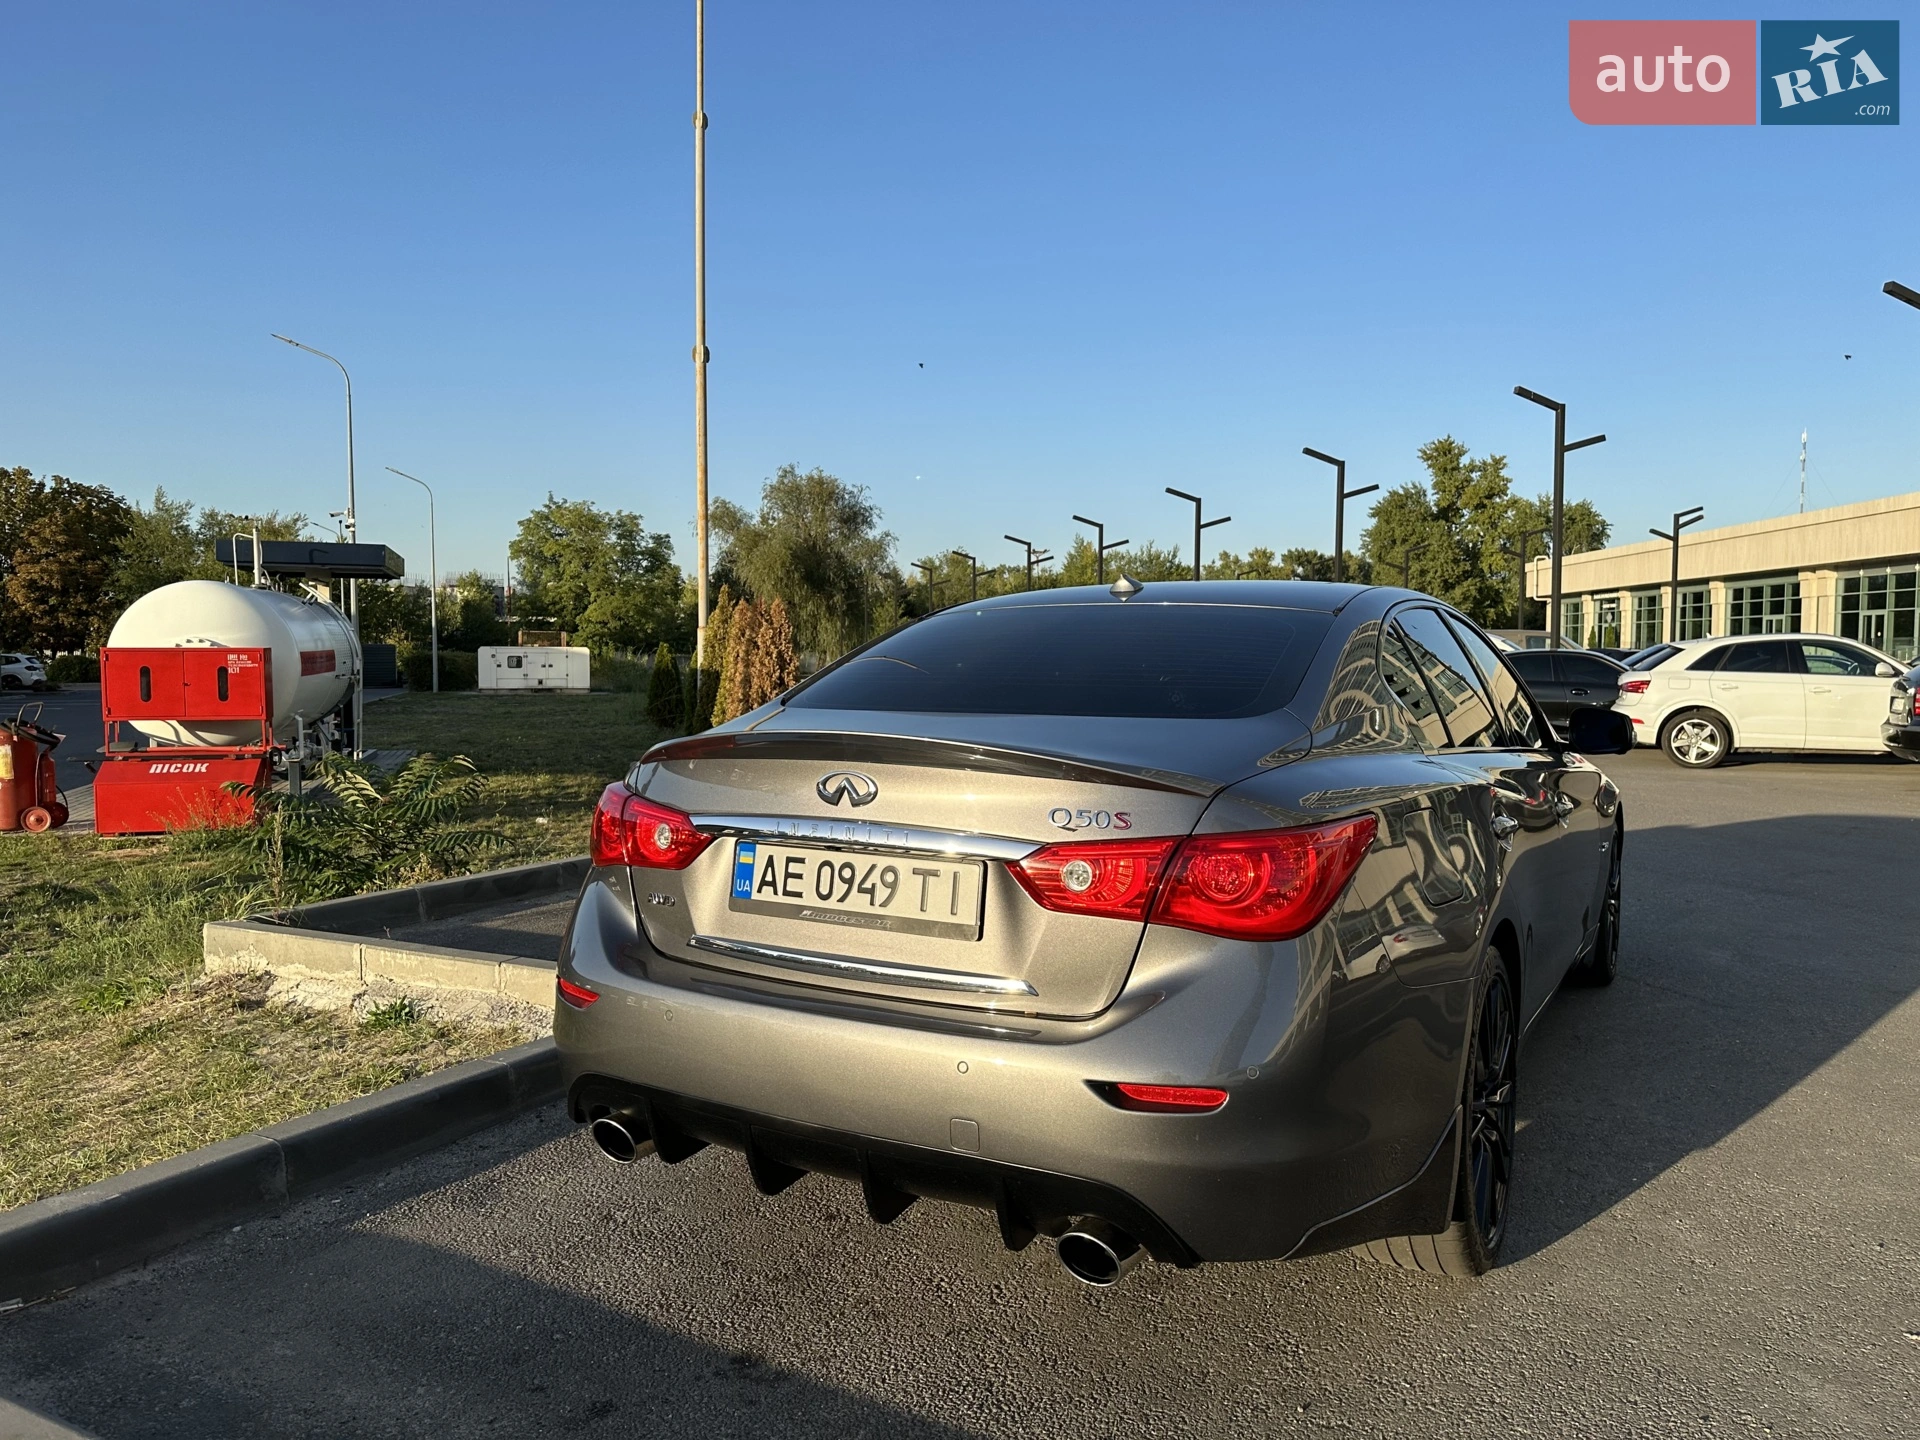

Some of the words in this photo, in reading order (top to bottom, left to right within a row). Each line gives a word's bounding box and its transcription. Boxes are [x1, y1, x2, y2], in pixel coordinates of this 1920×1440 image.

[774, 820, 910, 846] INFINITI
[736, 879, 751, 893] UA
[757, 854, 806, 899] AE
[815, 859, 900, 908] 0949
[912, 867, 961, 916] TI
[648, 891, 677, 908] AWD
